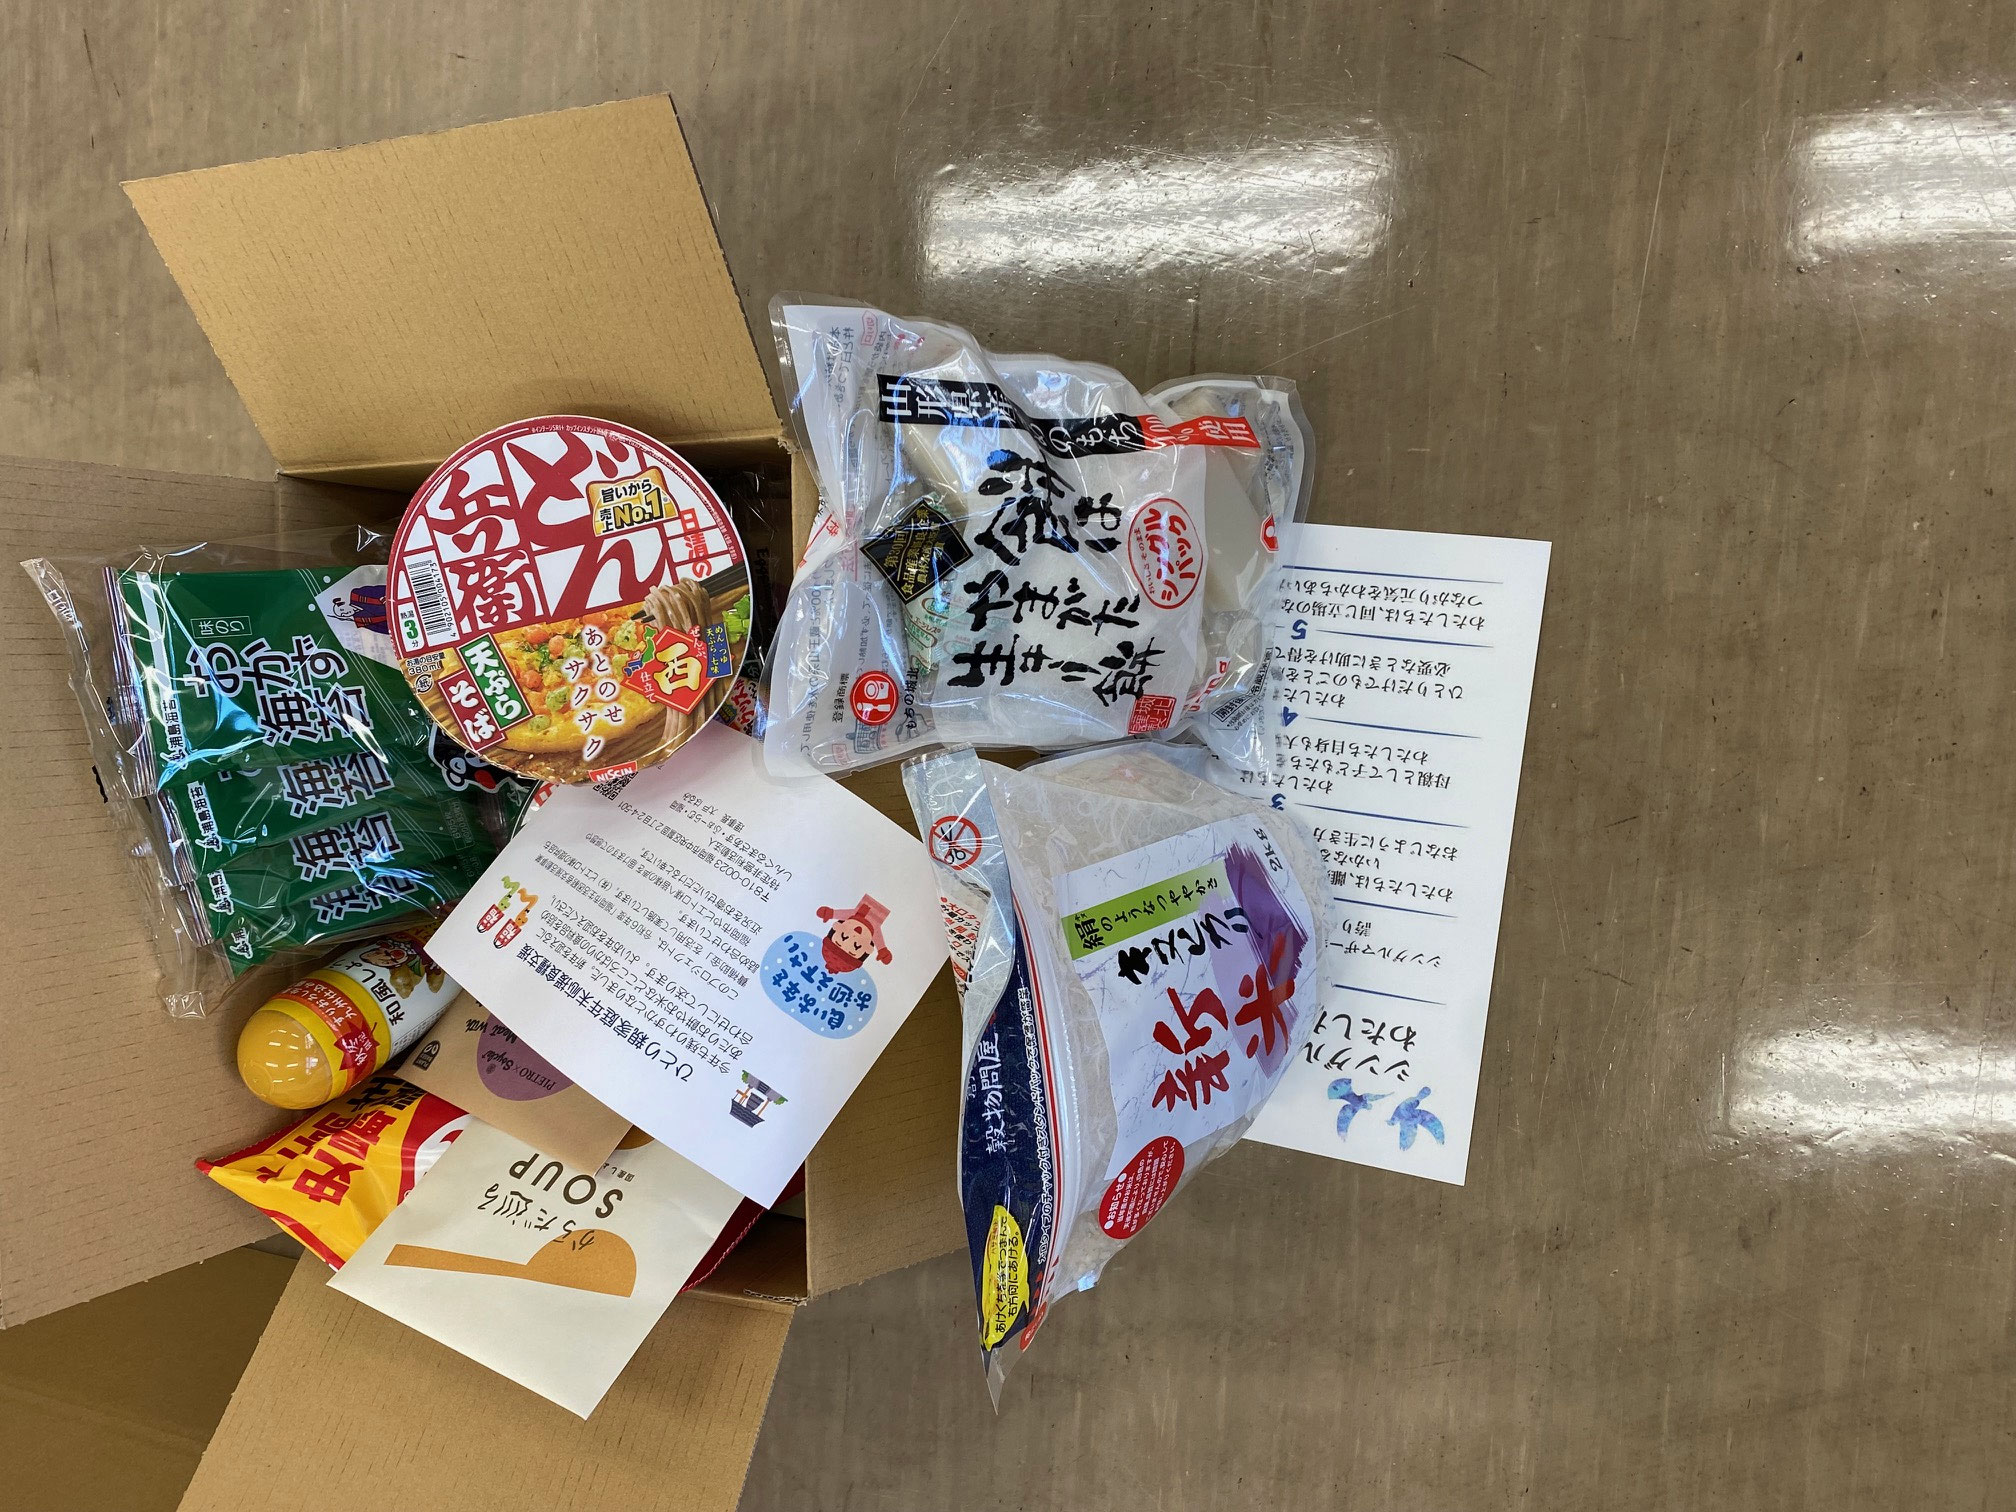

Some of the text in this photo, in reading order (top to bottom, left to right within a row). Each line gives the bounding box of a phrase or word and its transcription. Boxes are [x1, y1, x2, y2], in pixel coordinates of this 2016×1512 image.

[602, 479, 652, 503] 旨いから
[613, 487, 662, 529] No.1
[679, 508, 712, 578] 日清の
[1143, 508, 1178, 600] シングル
[1168, 515, 1195, 578] パック
[200, 617, 245, 636] 味のり
[963, 569, 1141, 634] やまがた
[1289, 618, 1308, 640] 5
[404, 620, 419, 640] 3
[412, 640, 419, 648] 分
[690, 626, 706, 658] ぜんぶ
[184, 636, 348, 695] おかず
[406, 652, 446, 667] お湯の目安量
[409, 662, 442, 675] 380ml
[465, 641, 521, 719] 天ぷら
[586, 626, 622, 724] あとのせ
[640, 672, 657, 702] 仕立て
[654, 643, 702, 695] 西
[258, 686, 373, 743] 海苔
[449, 680, 495, 742] そば
[565, 660, 603, 762] サクサク
[832, 673, 849, 722] 登録商標
[904, 667, 918, 728] もちの城北
[279, 751, 392, 816] 海苔
[595, 767, 636, 784] NISSIN
[189, 784, 213, 833] 浦島海苔
[705, 836, 781, 891] 特定非営利活動法人
[1253, 826, 1283, 871] 2kg
[481, 908, 500, 927] 福
[498, 923, 517, 943] 福
[1075, 877, 1217, 947] 絹のようなつややかさ
[674, 909, 760, 974] 詰め合わせています。
[772, 968, 843, 1029] 良いお年を
[783, 935, 870, 1010] お迎え下さい
[1151, 932, 1296, 1111] 新米
[518, 1066, 555, 1090] PIETRO
[508, 1154, 624, 1218] SOUP
